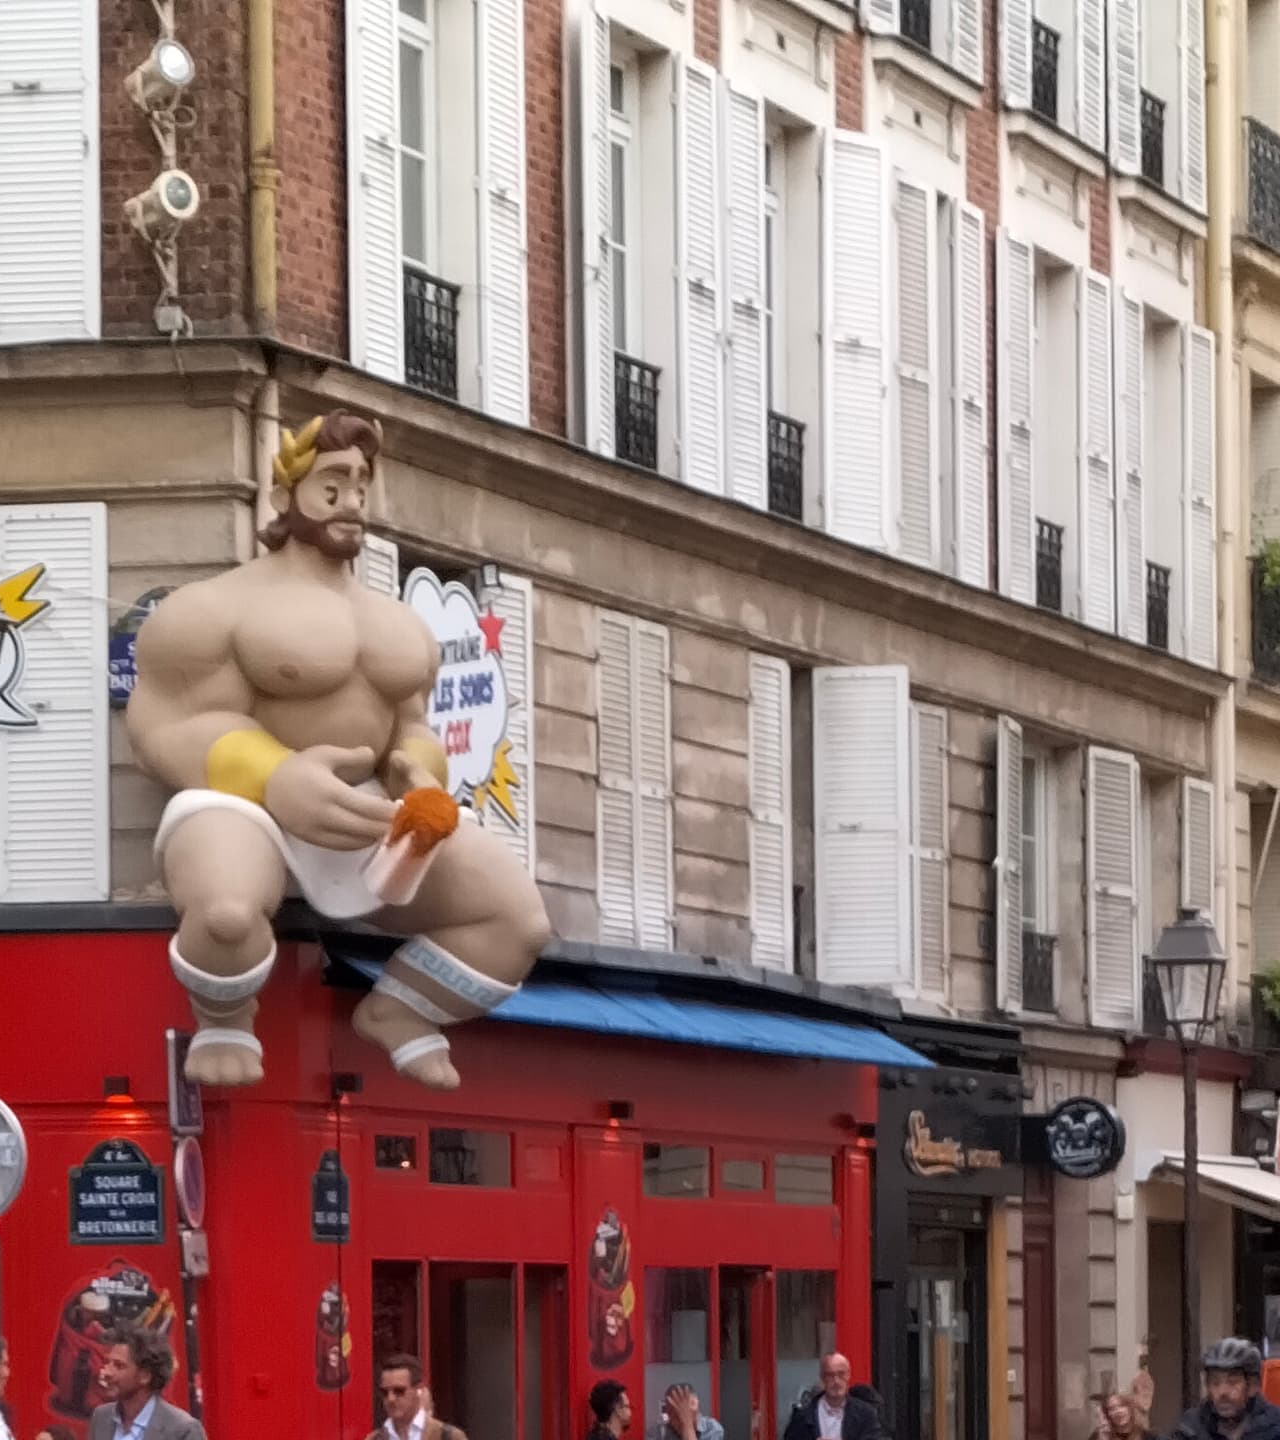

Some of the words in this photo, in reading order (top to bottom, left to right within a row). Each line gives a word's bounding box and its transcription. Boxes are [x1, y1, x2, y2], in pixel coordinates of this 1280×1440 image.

[94, 1175, 141, 1190] SQUARE
[78, 1192, 119, 1206] SAINTE
[121, 1192, 157, 1206] CROIX
[77, 1220, 158, 1235] BRETONNERIE
